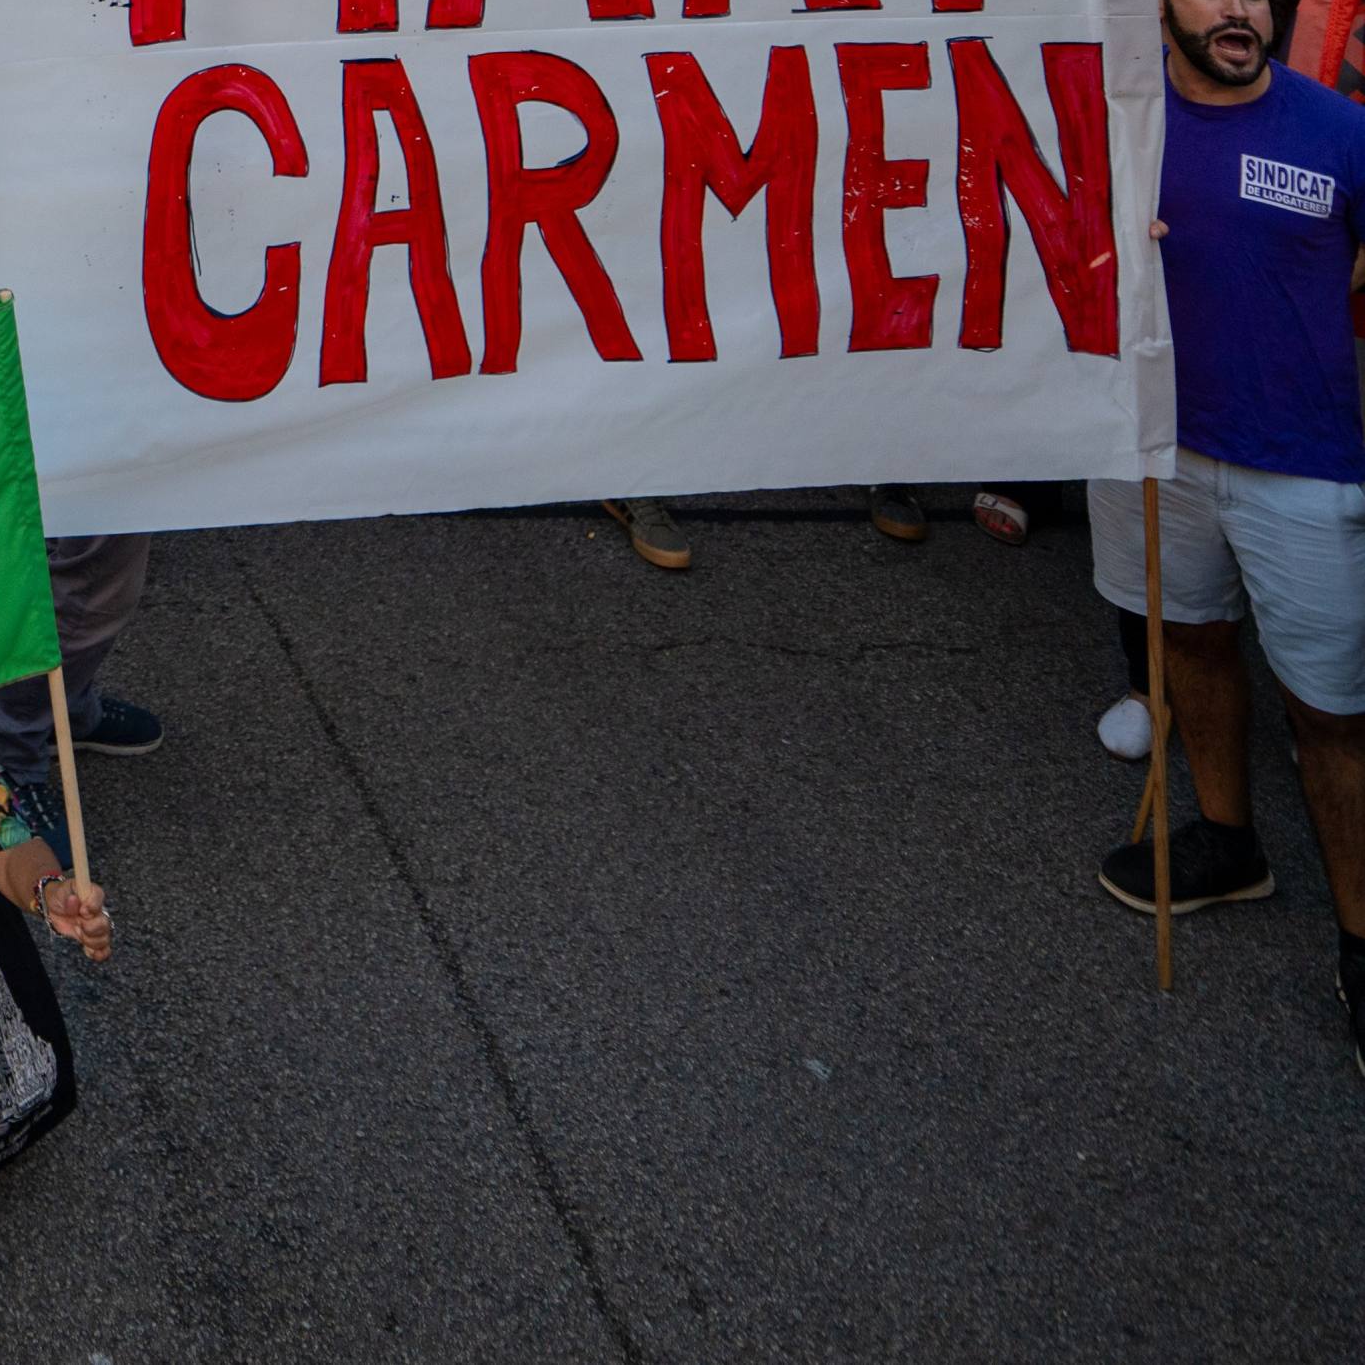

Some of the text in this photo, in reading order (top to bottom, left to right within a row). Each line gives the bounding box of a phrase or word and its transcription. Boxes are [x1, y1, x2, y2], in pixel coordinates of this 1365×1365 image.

[1245, 158, 1331, 202] SINDICAT
[1247, 185, 1328, 213] DE LLOGATERES
[142, 36, 1121, 402] CARMEN
